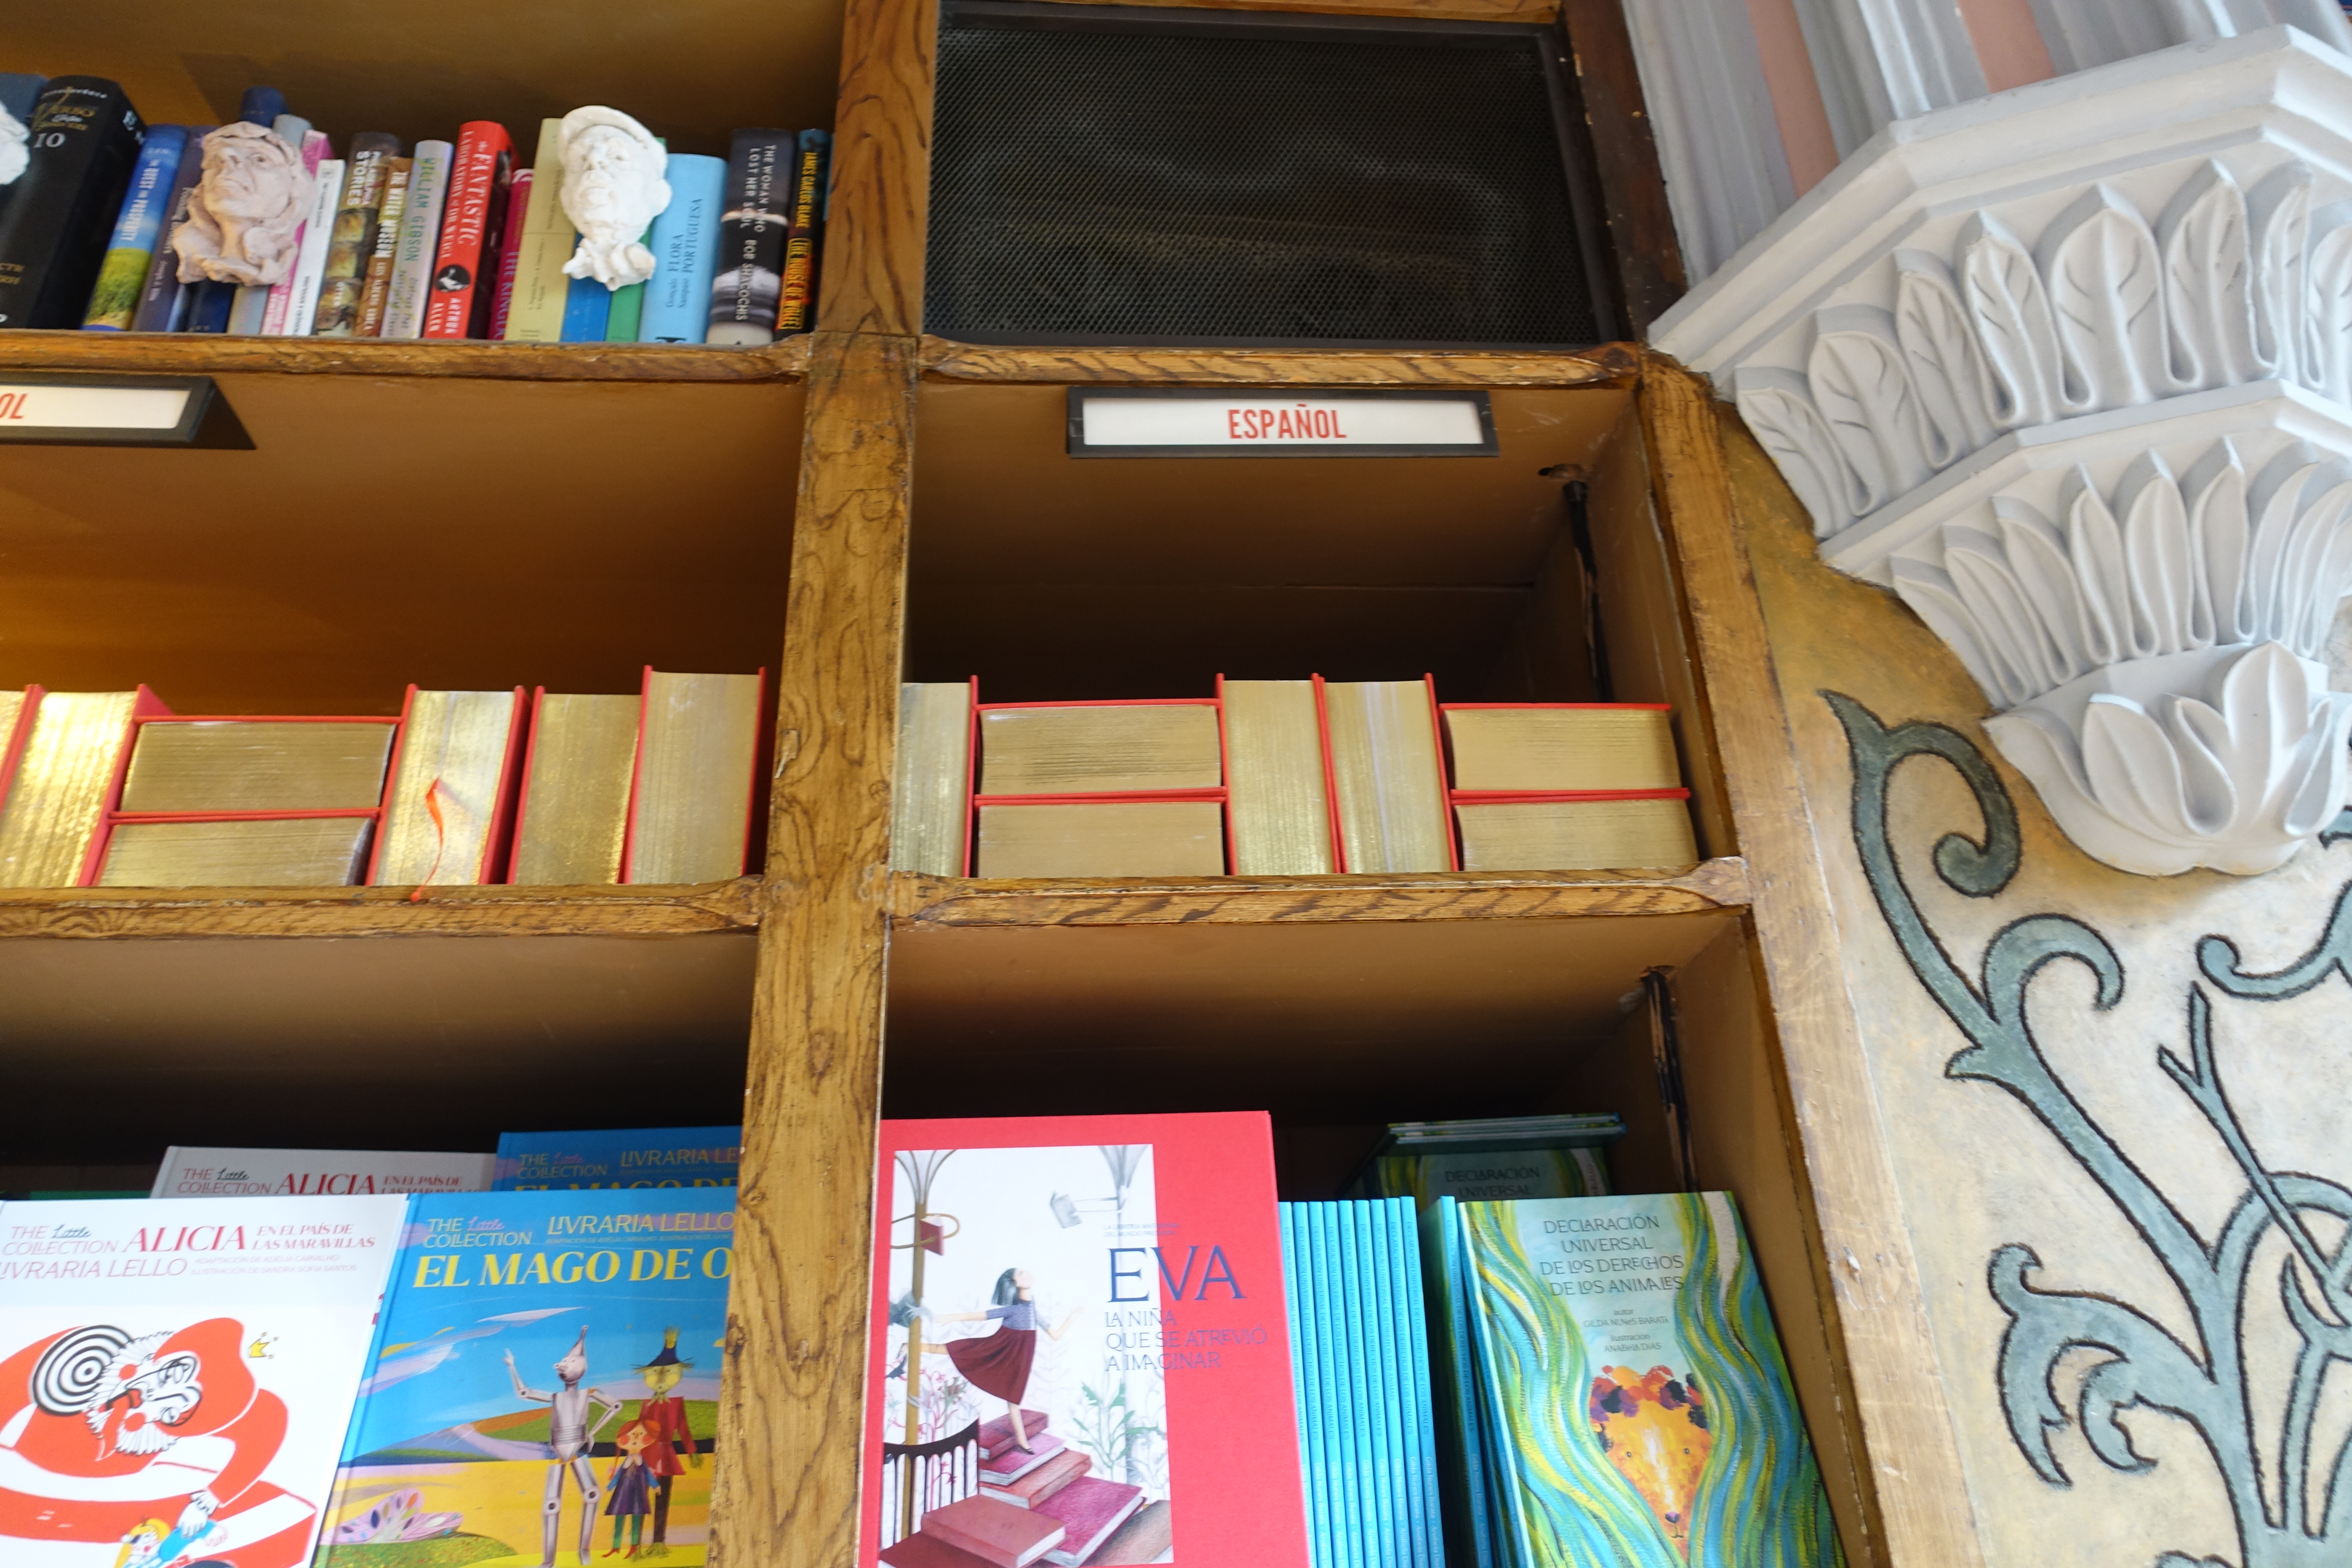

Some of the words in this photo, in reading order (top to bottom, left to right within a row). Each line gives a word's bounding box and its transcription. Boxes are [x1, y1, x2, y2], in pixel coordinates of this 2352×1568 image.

[33, 133, 66, 148] 10
[451, 131, 474, 197] LABORATORY
[747, 147, 762, 174] LOST
[763, 145, 777, 162] THE
[802, 152, 818, 175] JAMES
[347, 151, 371, 205] STORIES
[390, 172, 408, 185] THE
[415, 157, 435, 208] WILLIAM
[744, 177, 757, 197] HER
[759, 165, 774, 204] WOMAN
[458, 153, 493, 246] FANTASTIC
[798, 176, 816, 204] CARLOS
[740, 201, 756, 229] SOUL
[754, 207, 769, 233] WHO
[795, 205, 812, 228] BLAKE
[376, 220, 397, 257] MUSEUM
[405, 215, 426, 261] GIBSON
[681, 198, 703, 273] PORTUGUESA
[667, 234, 684, 272] FLORA
[743, 239, 757, 260] BOB
[790, 239, 809, 257] THE
[786, 258, 806, 284] HOUSE
[735, 263, 754, 321] SHACOCHIS
[785, 286, 804, 299] OF
[428, 303, 445, 332] ALLEN
[444, 297, 462, 334] ARTHUR
[779, 300, 802, 328] WOLFE
[1228, 404, 1347, 439] ESPAÑOL
[519, 1154, 550, 1167] THE
[620, 1149, 709, 1168] LIVRARIA
[709, 1147, 738, 1164] LE
[184, 1168, 214, 1180] THE
[217, 1167, 250, 1180] Little
[517, 1164, 609, 1179] COLLECTION
[178, 1181, 272, 1194] COLLECTION
[274, 1173, 376, 1194] ALICIA
[11, 1225, 50, 1240] THE
[51, 1223, 93, 1239] Little
[256, 1225, 279, 1236] EN
[279, 1225, 297, 1236] EL
[299, 1222, 332, 1235] PAÍS
[333, 1223, 355, 1234] DE
[428, 1217, 465, 1232] THE
[467, 1216, 505, 1231] Little
[547, 1214, 655, 1235] LIVRARIA
[659, 1211, 735, 1231] LELLO
[1543, 1213, 1660, 1234] DECLARACIÓN
[2, 1239, 120, 1256] COLLECTION
[122, 1225, 245, 1253] ALICIA
[251, 1238, 281, 1250] LAS
[283, 1236, 377, 1250] MARAVILLAS
[422, 1231, 533, 1248] COLLECTION
[1561, 1236, 1654, 1253] UNIVERSAL
[107, 1258, 188, 1278] LELLO
[412, 1254, 471, 1288] EL
[478, 1250, 620, 1286] MAGO
[628, 1248, 694, 1281] DE
[702, 1246, 734, 1280] O
[1107, 1245, 1247, 1303] EVA
[1540, 1261, 1565, 1275] DE
[1568, 1259, 1594, 1274] LOS
[1597, 1255, 1684, 1272] DERECHOS
[1550, 1281, 1576, 1296] DE
[1579, 1280, 1605, 1295] LOS
[1609, 1276, 1684, 1292] ANIMALES
[1105, 1311, 1123, 1327] LA
[1128, 1307, 1177, 1327] NIÑA
[1584, 1319, 1608, 1328] GILDA
[1106, 1332, 1150, 1352] QUE
[1156, 1331, 1180, 1348] SE
[1184, 1324, 1267, 1347] ATREVIÓ
[1611, 1333, 1651, 1341] ilustración
[1106, 1356, 1121, 1371] A
[1124, 1351, 1222, 1371] IMAGINAR
